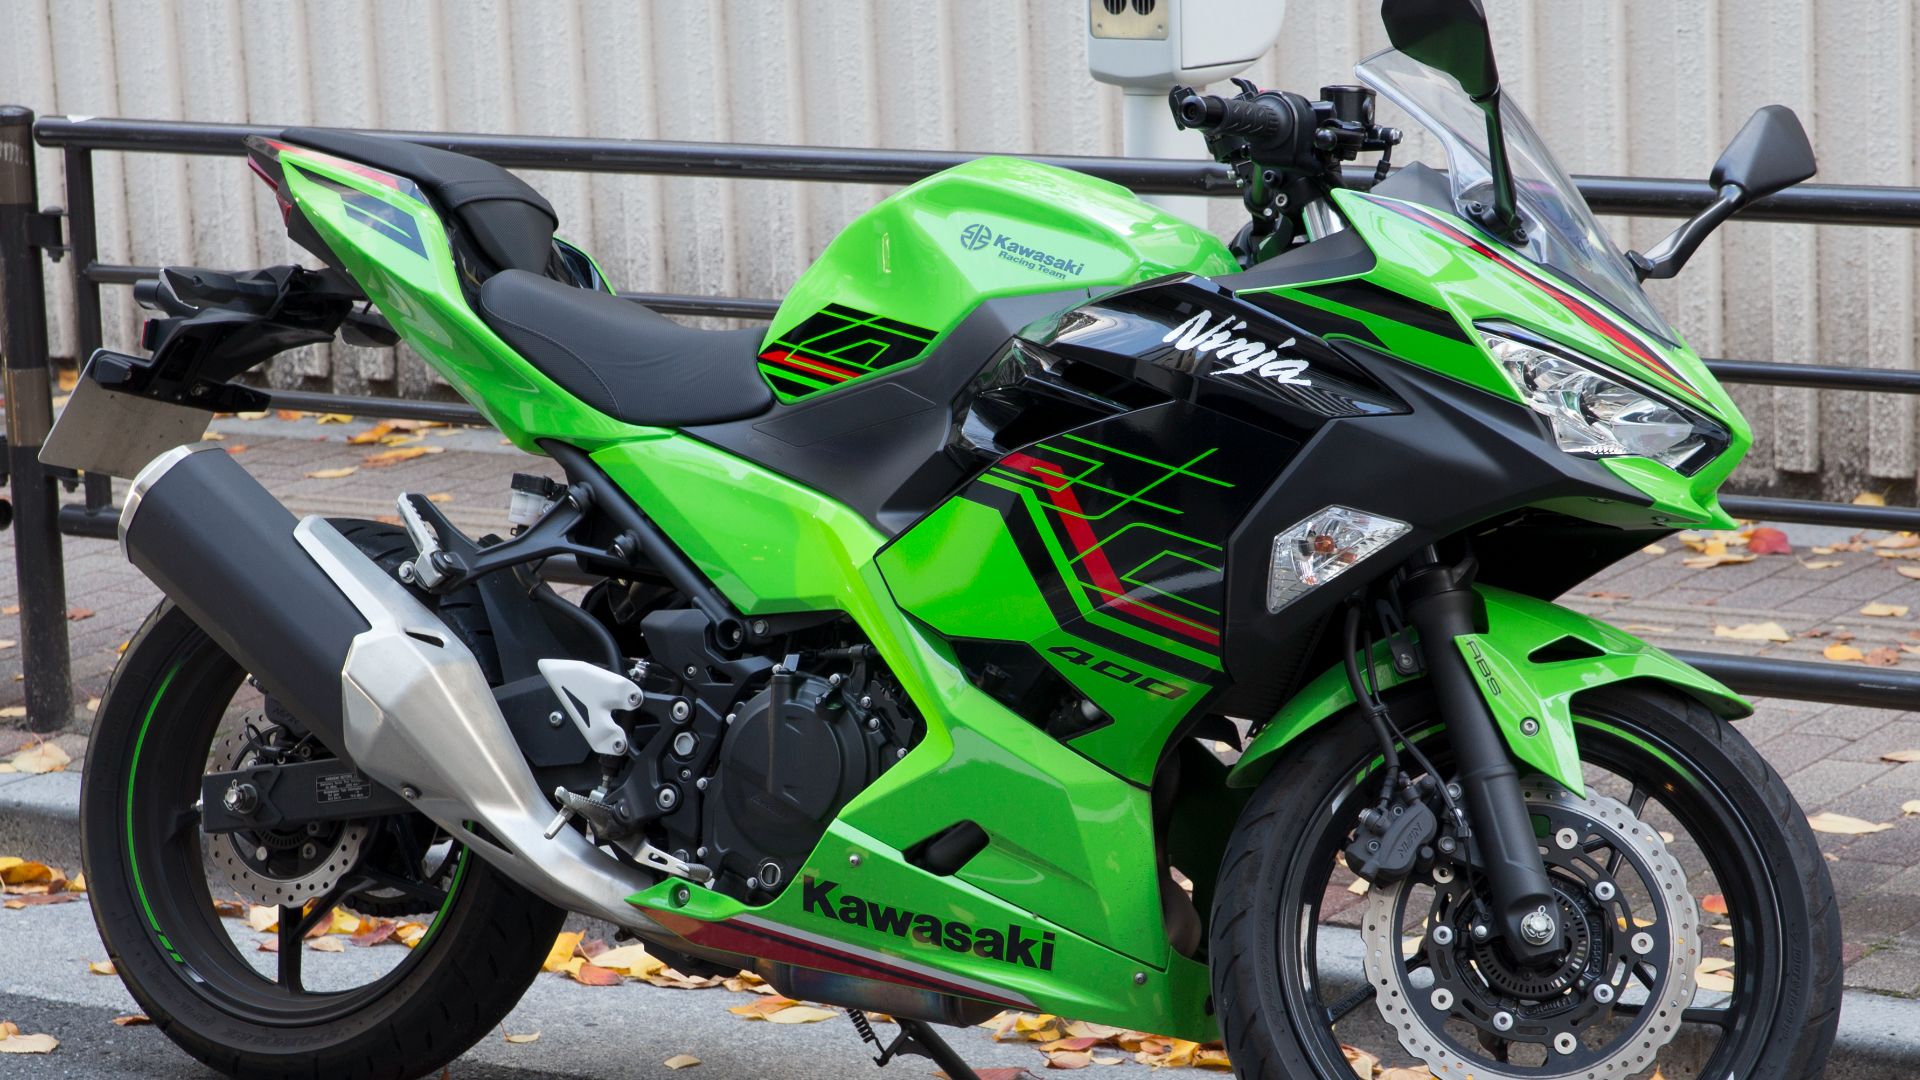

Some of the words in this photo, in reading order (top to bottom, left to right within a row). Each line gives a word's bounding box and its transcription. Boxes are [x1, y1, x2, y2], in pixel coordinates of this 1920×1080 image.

[993, 234, 1084, 276] Kawasaki
[998, 251, 1036, 270] Racing
[1038, 264, 1067, 280] Team
[1162, 309, 1312, 387] Ninja
[1046, 646, 1189, 700] 400
[1466, 640, 1501, 696] ABS
[802, 874, 1056, 972] Kawasaki
